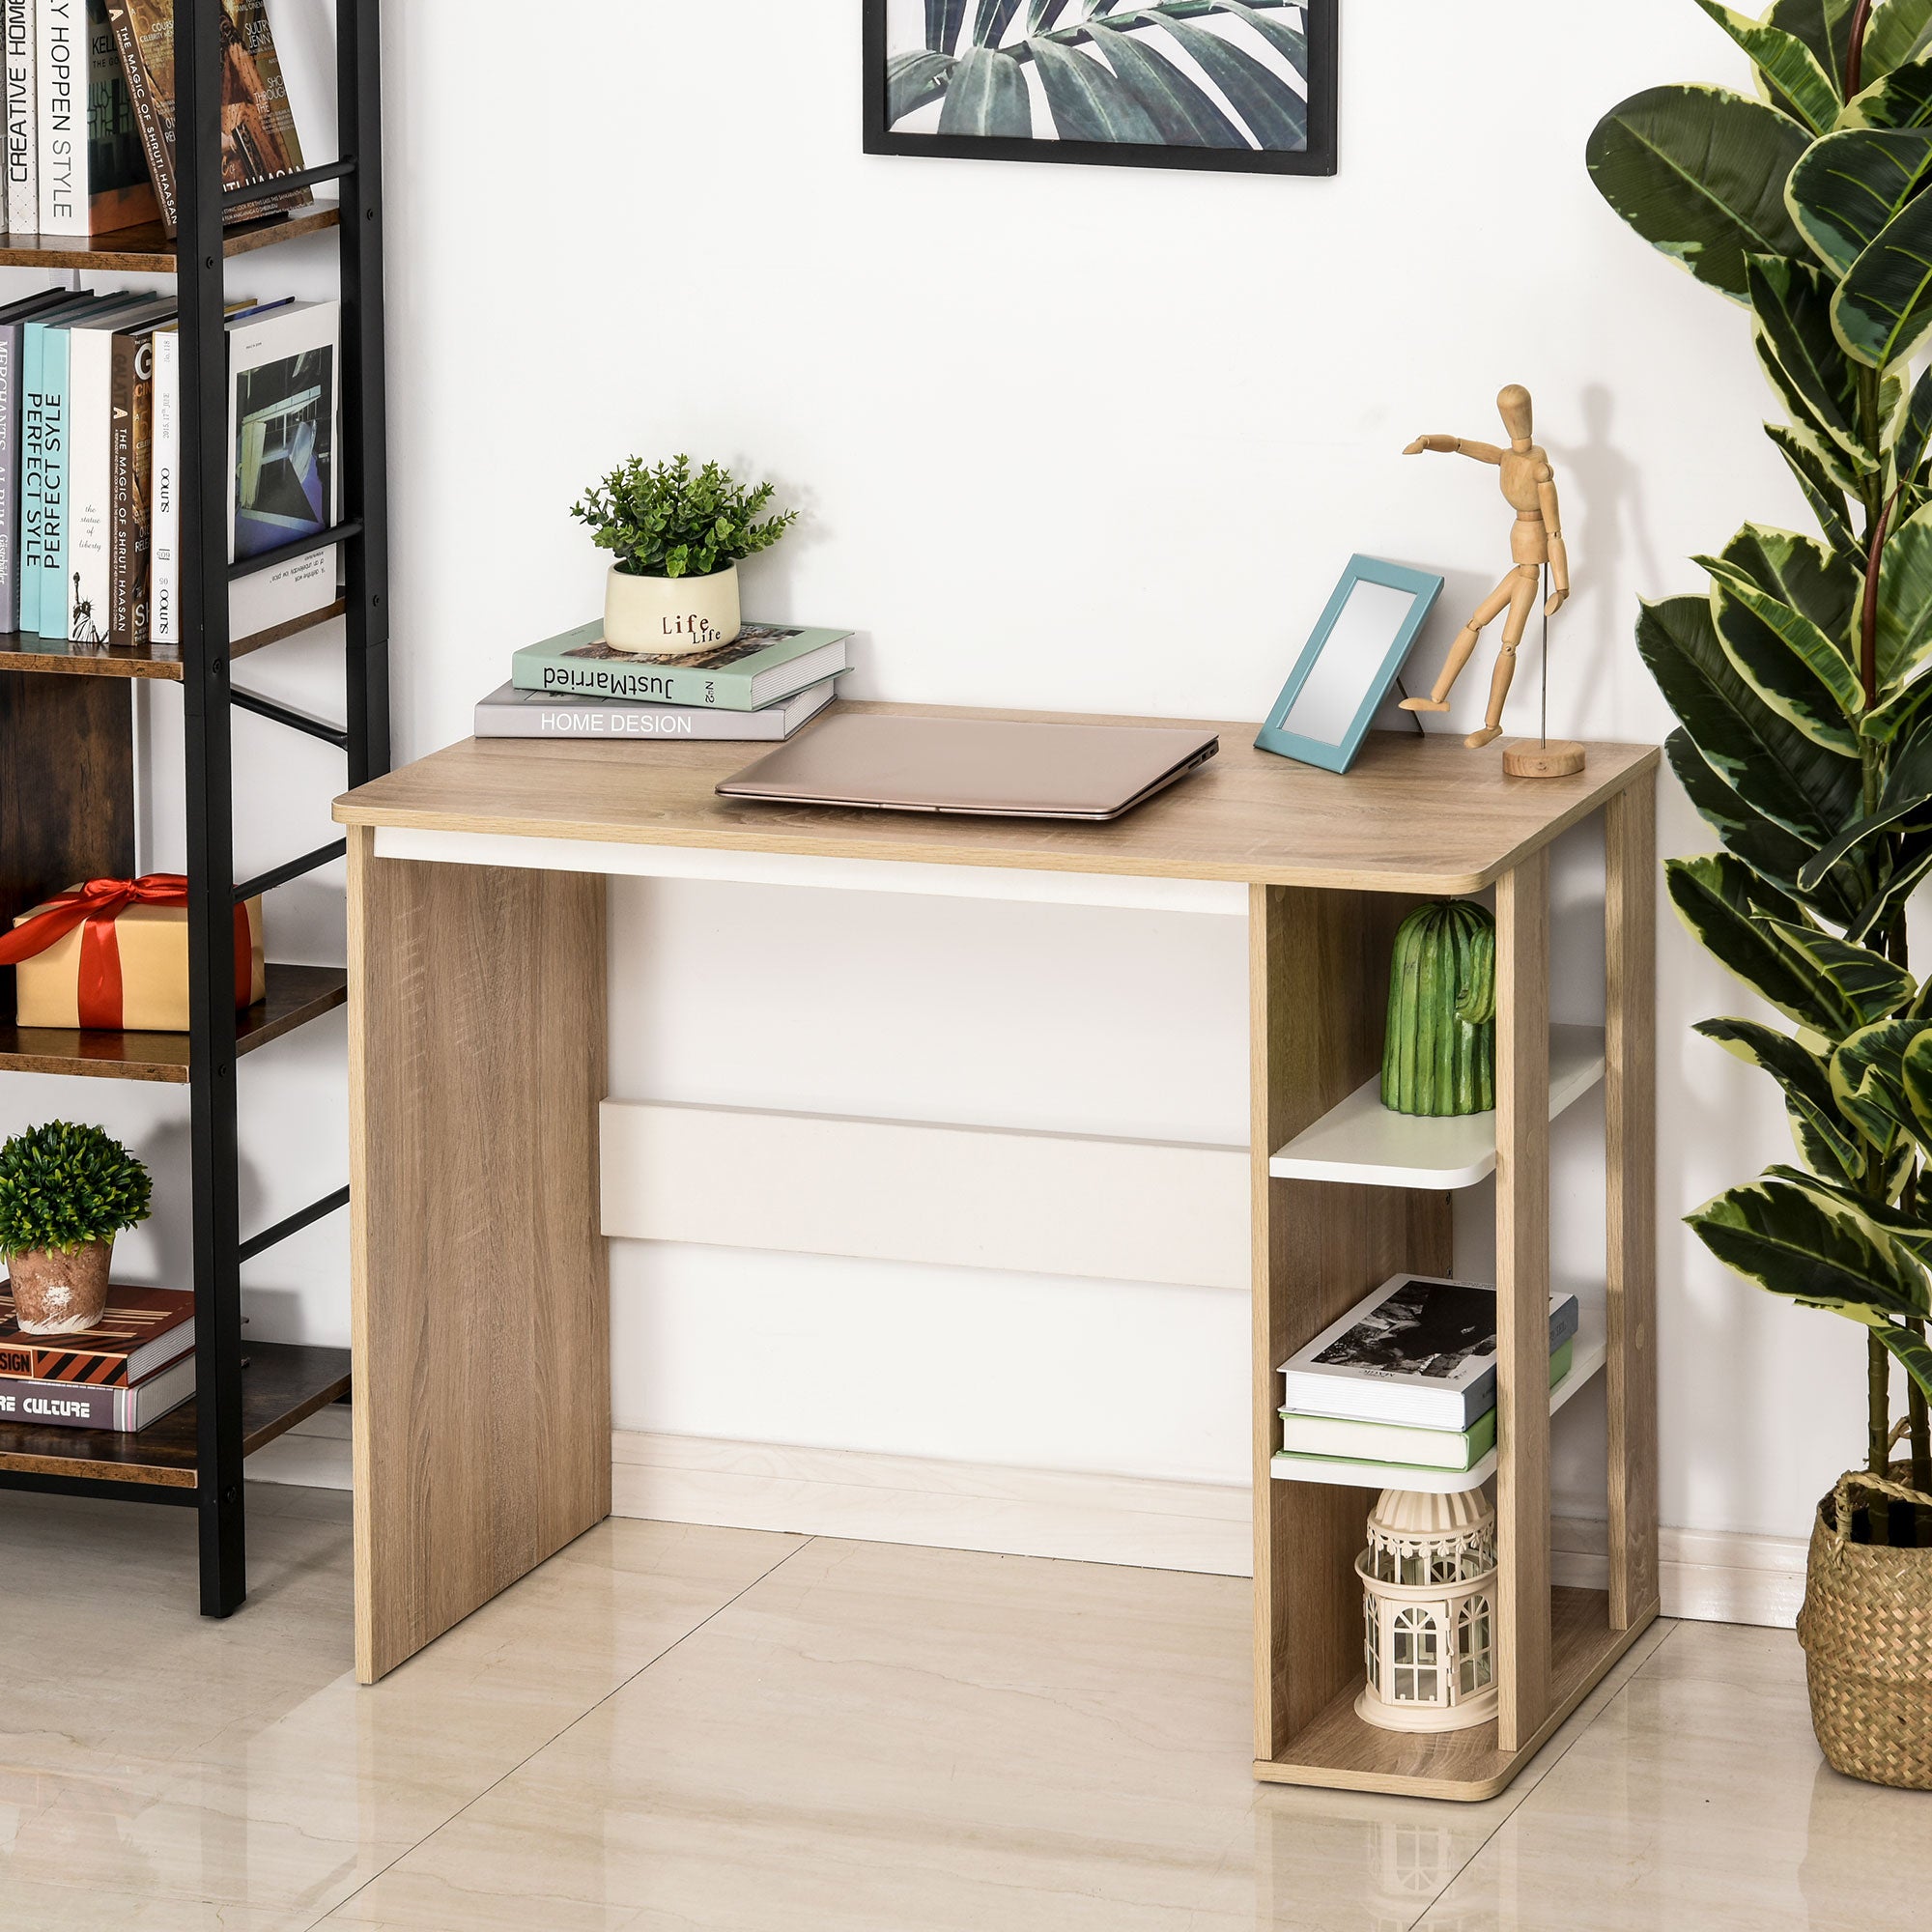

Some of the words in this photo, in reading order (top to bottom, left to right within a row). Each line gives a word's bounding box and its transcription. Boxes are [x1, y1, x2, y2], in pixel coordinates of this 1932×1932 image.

[93, 58, 106, 69] THE
[50, 27, 71, 130] HOPPEN
[255, 101, 270, 114] THE
[8, 68, 27, 182] CREATIVE
[120, 26, 132, 48] THE
[127, 54, 145, 99] MAGIC
[140, 103, 151, 121] OF
[146, 126, 164, 168] SHRUTI
[158, 173, 178, 224] HAASAN
[52, 140, 71, 217] STYLE
[45, 394, 60, 451] SYLE
[27, 393, 42, 502] PERFECT
[119, 429, 128, 450] THE
[44, 459, 60, 569] PERFECT
[84, 504, 97, 513] the
[119, 507, 127, 526] OF
[27, 510, 41, 567] SYLE
[86, 526, 95, 537] of
[78, 539, 101, 553] liberty
[663, 613, 709, 635] Life
[693, 629, 721, 644] Life
[543, 668, 674, 699] JustMarried
[541, 713, 604, 732] HOME
[23, 1398, 90, 1418] CULTURE
